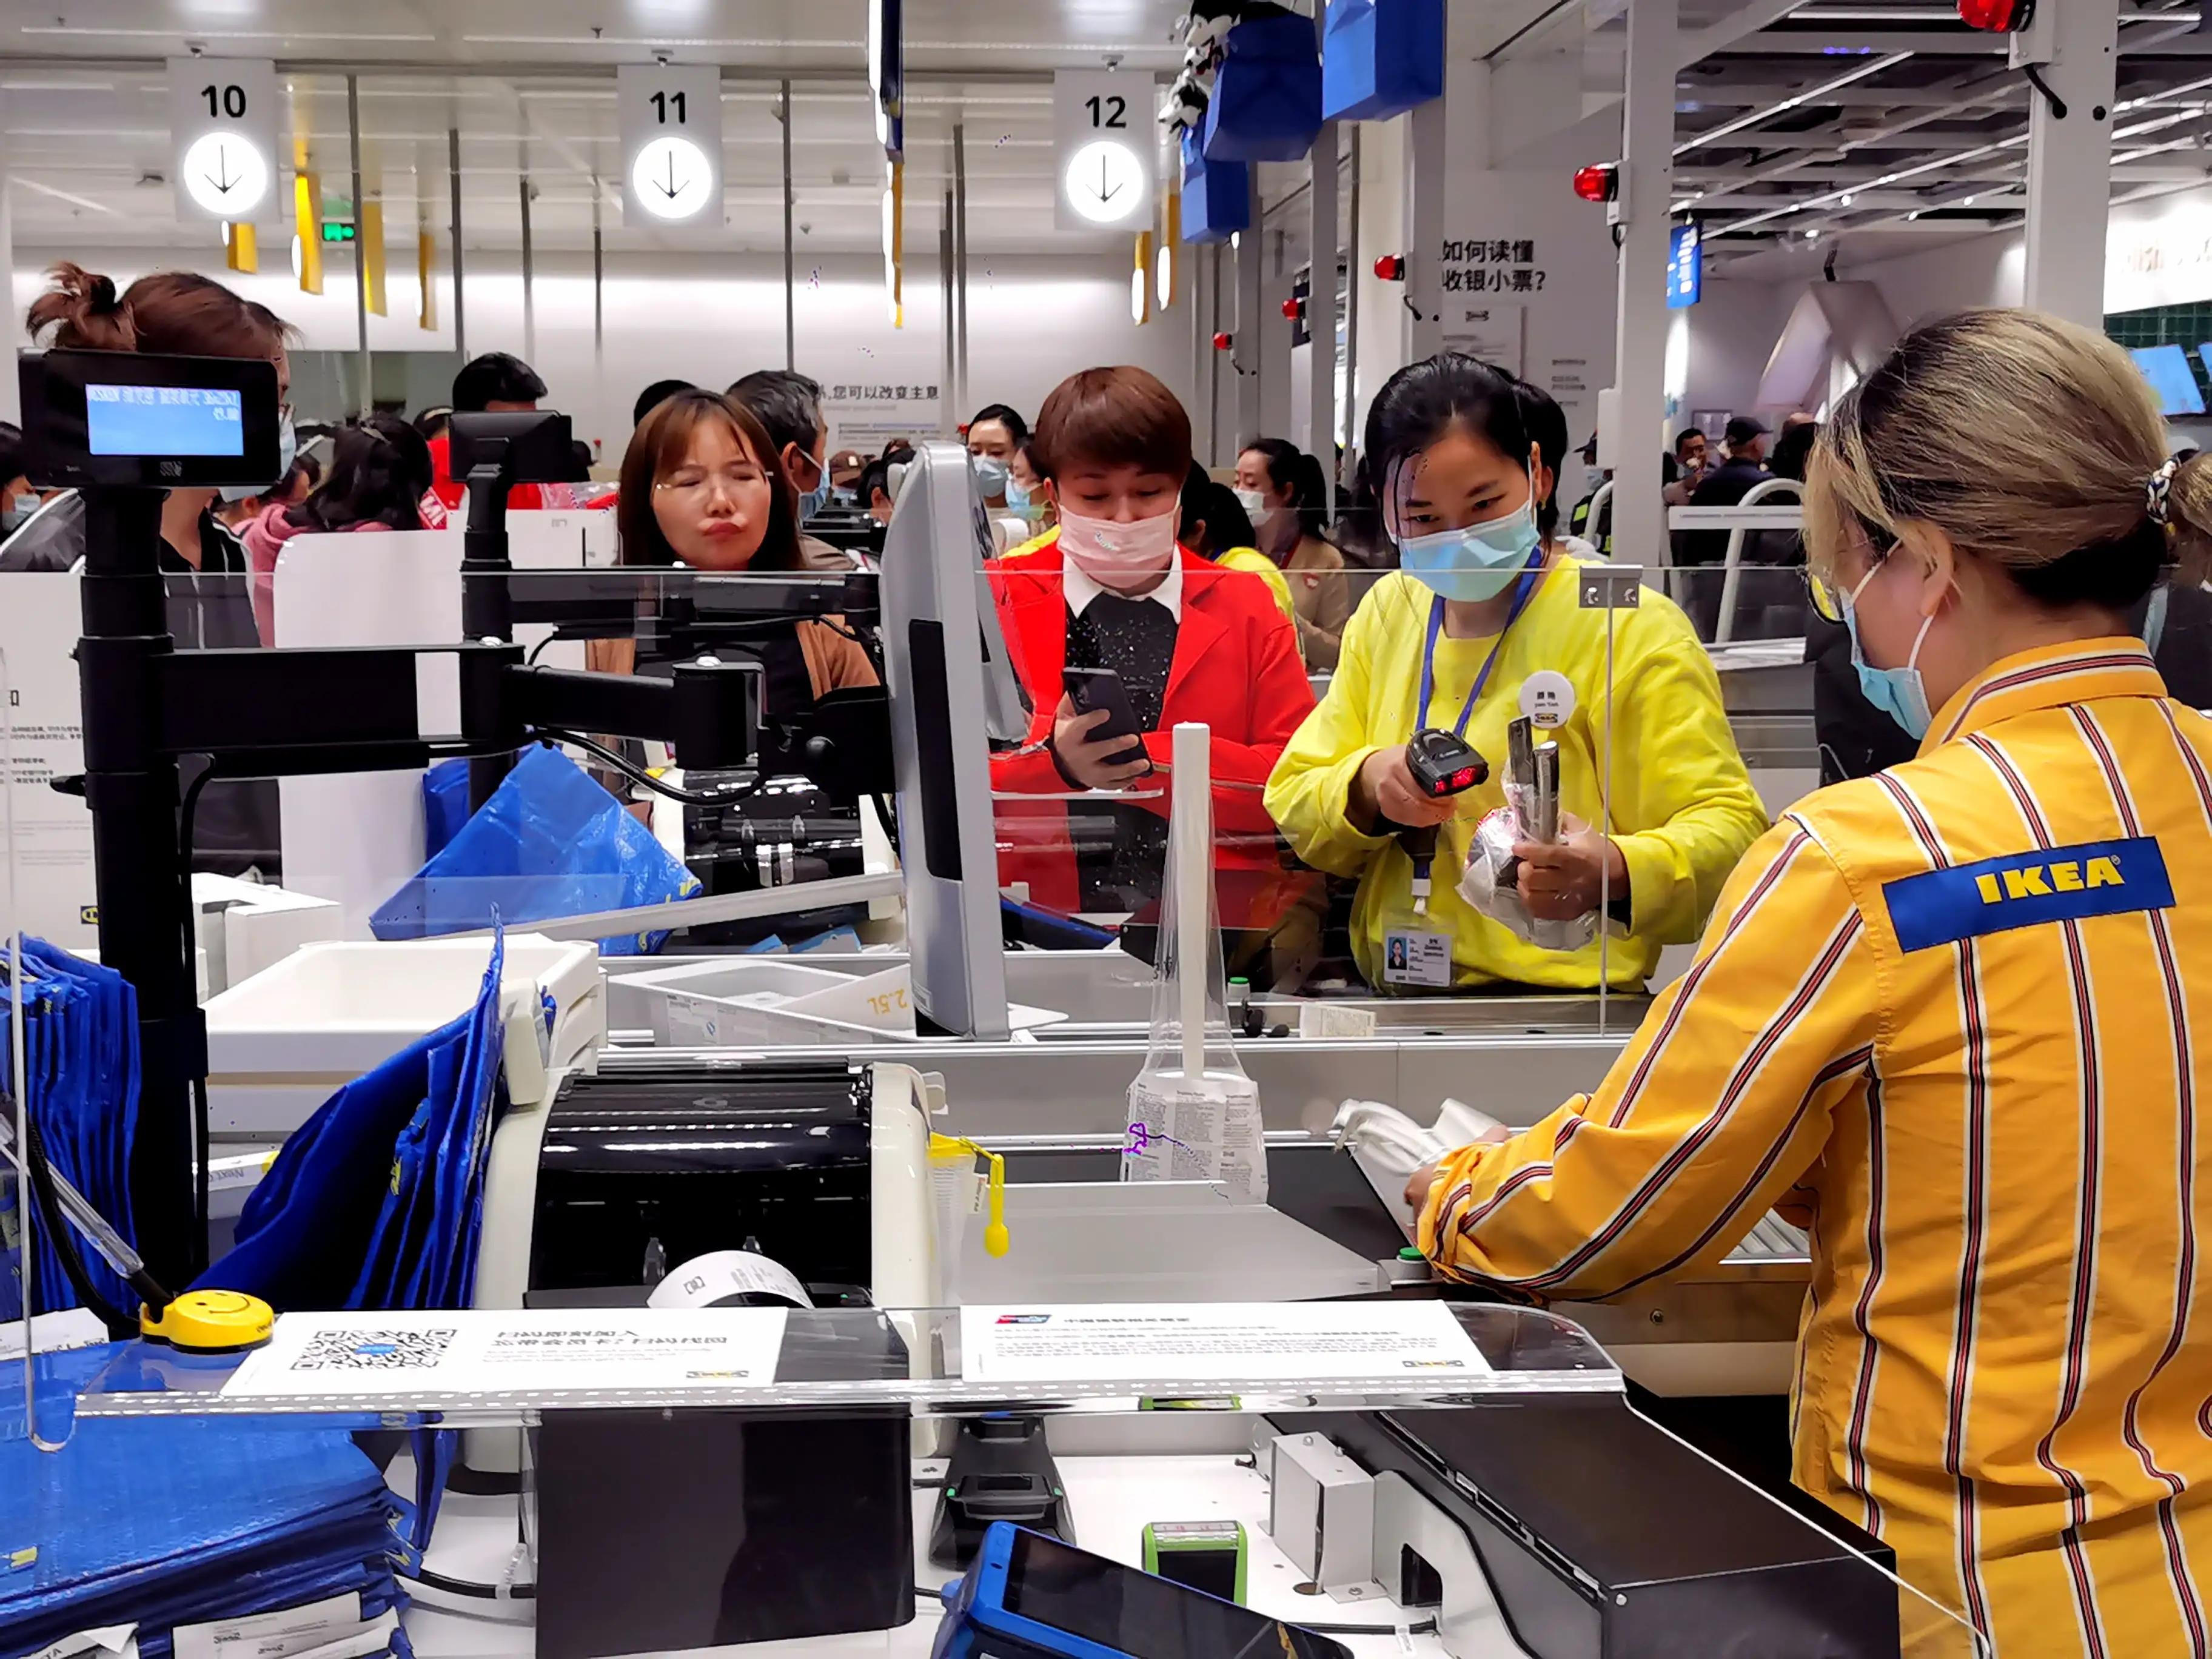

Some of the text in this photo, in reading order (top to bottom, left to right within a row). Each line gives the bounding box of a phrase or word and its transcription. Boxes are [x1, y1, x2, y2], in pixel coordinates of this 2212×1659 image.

[201, 85, 246, 118] 10
[649, 90, 686, 124] 11
[1085, 96, 1127, 128] 12
[1442, 240, 1534, 263] 如何读懂
[1975, 856, 2125, 903] IKEA
